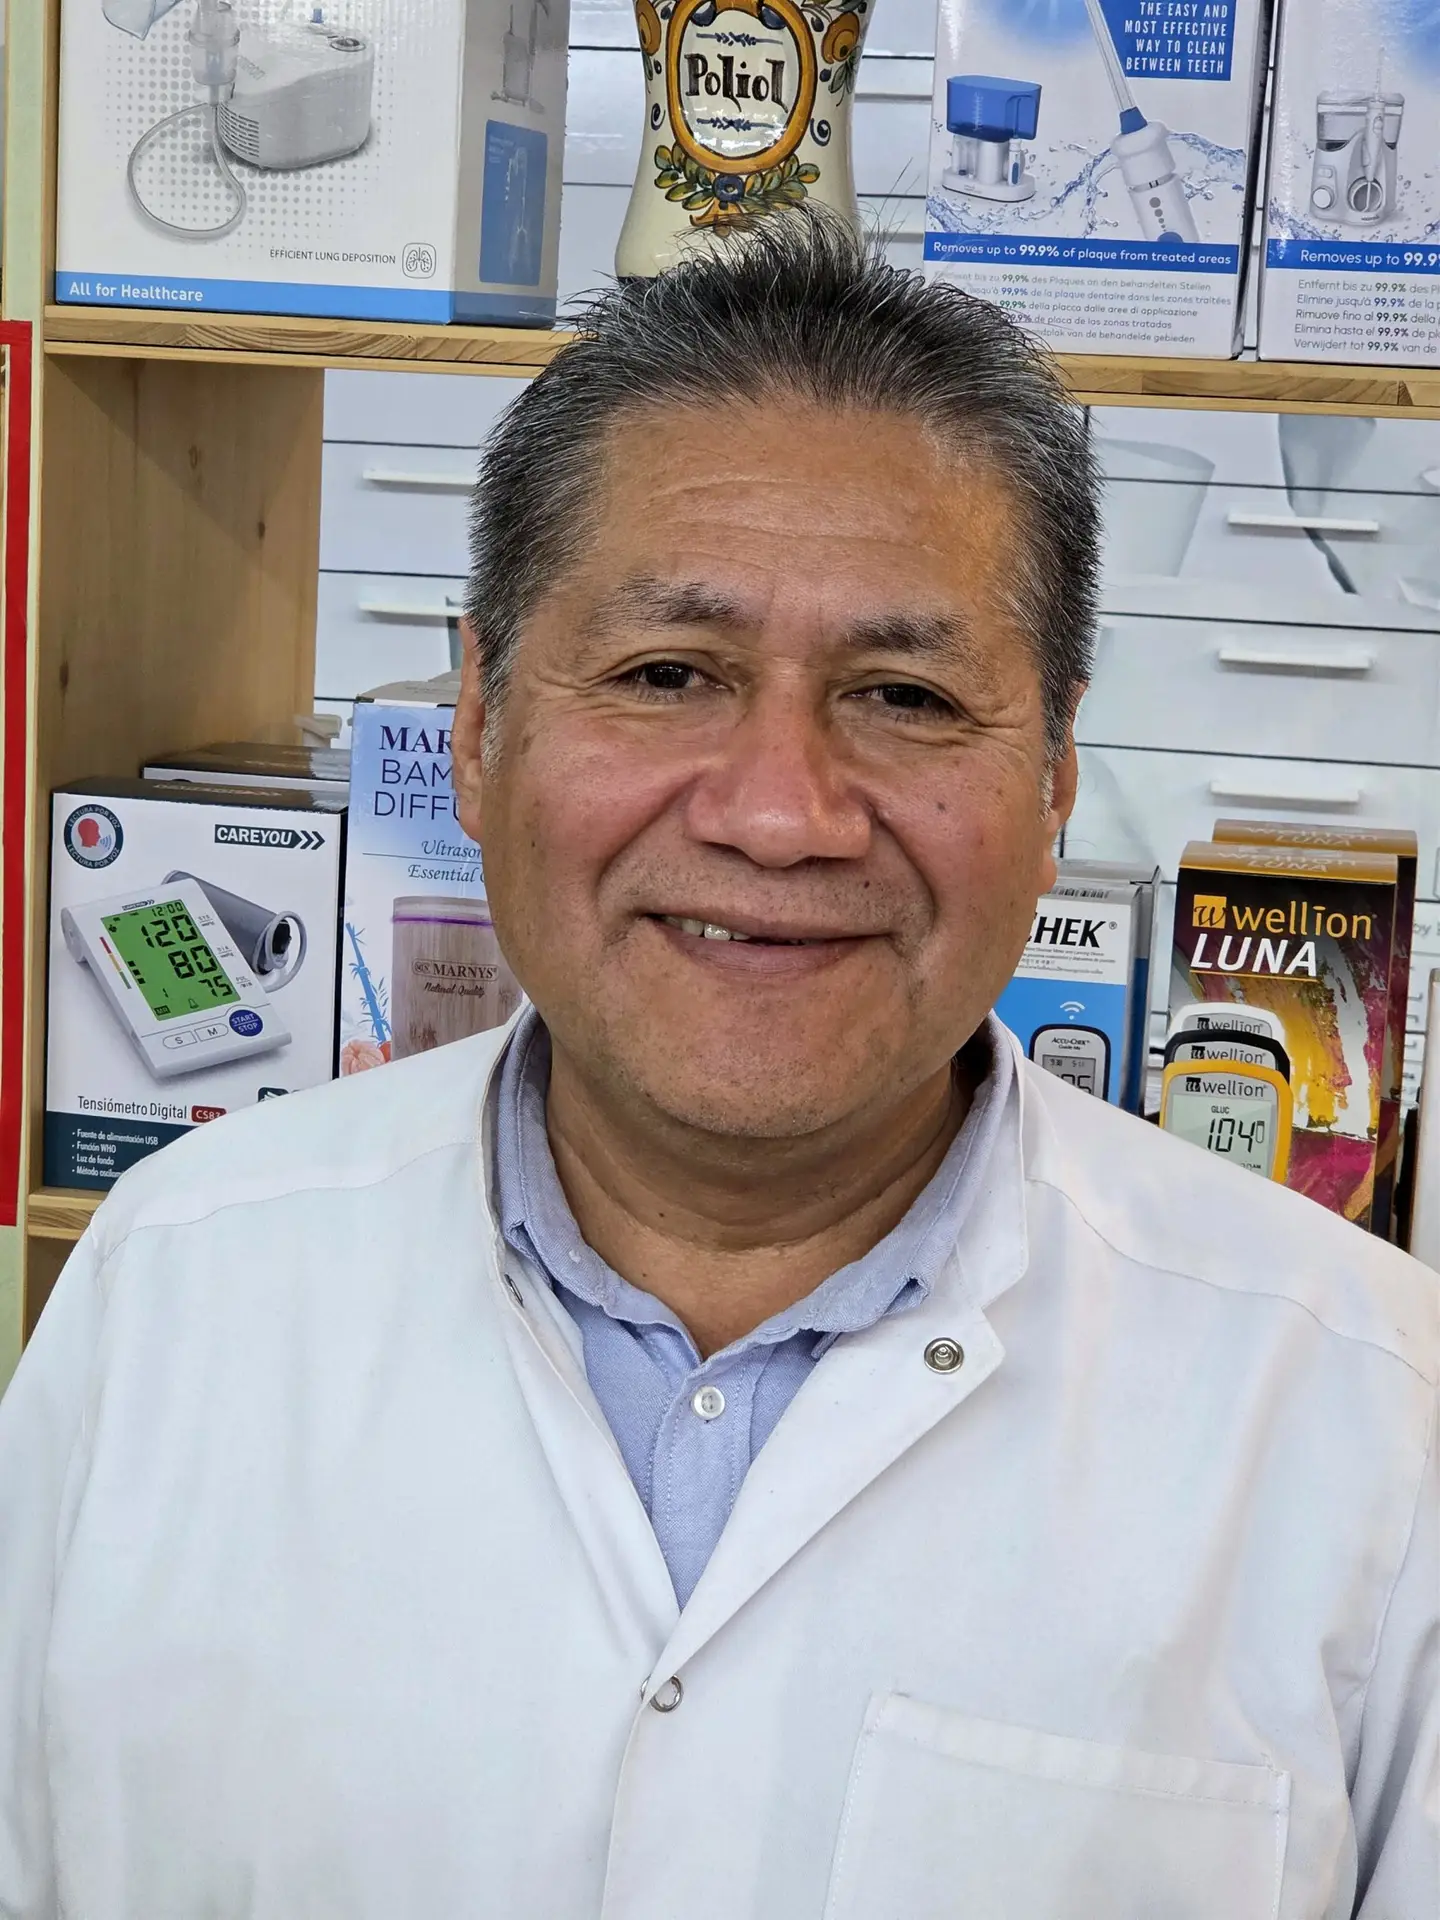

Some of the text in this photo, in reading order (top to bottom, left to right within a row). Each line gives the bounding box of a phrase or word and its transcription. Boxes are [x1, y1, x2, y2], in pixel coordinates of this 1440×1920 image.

[1140, 2, 1228, 19] THE EASY AND
[1124, 20, 1227, 37] MOST EFFECTIVE
[1136, 38, 1226, 55] WAY TO CLEAN
[1126, 57, 1224, 74] BETWEEN TEETH
[684, 53, 788, 113] Poliol
[270, 249, 396, 264] EFFICIENT LUNG DEPOSITION
[933, 241, 1231, 265] Removes up to 99.9% of plaque from treated areas
[1300, 249, 1440, 268] Removes up to 99.9
[69, 282, 203, 302] All for Healthcare
[1031, 275, 1048, 284] des
[1049, 276, 1086, 286] Plaques
[1087, 278, 1099, 286] an
[1101, 278, 1118, 287] den
[1120, 279, 1177, 290] behandelten
[1179, 282, 1211, 292] Stellen
[1298, 279, 1340, 291] Entfernt
[1342, 280, 1357, 291] bis
[1360, 283, 1373, 292] zu
[1409, 284, 1428, 294] des
[1030, 287, 1042, 297] de
[1044, 288, 1053, 298] la
[1054, 289, 1085, 300] plaque
[1087, 290, 1126, 301] dentaire
[1127, 292, 1150, 302] dans
[1151, 292, 1165, 303] les
[1166, 295, 1194, 304] zones
[1408, 299, 1422, 309] de
[1424, 299, 1434, 309] la
[1028, 301, 1050, 311] della
[1052, 302, 1081, 312] placca
[1083, 304, 1106, 313] dalle
[1107, 306, 1128, 314] aree
[1130, 304, 1139, 314] di
[1140, 306, 1198, 318] applicazione
[1295, 309, 1340, 320] Rimuove
[1342, 310, 1361, 321] fino
[1363, 311, 1374, 321] al
[1410, 314, 1436, 324] della
[1034, 314, 1046, 324] de
[1047, 315, 1073, 327] placa
[1074, 316, 1087, 326] de
[1088, 317, 1102, 326] las
[1103, 318, 1130, 328] zonas
[1131, 318, 1172, 330] tratadas
[1067, 331, 1084, 340] van
[1085, 330, 1097, 339] de
[1099, 330, 1152, 341] behandelde
[1153, 333, 1195, 344] gebieden
[1294, 323, 1332, 335] Elimina
[1334, 324, 1364, 336] hasta
[1365, 326, 1376, 336] el
[1411, 328, 1425, 339] de
[1293, 338, 1347, 352] Verwijdert
[1350, 340, 1365, 350] tot
[1401, 344, 1420, 354] van
[1422, 343, 1437, 354] de
[381, 758, 455, 788] BAM
[216, 826, 293, 846] CAREYOU
[407, 864, 479, 883] Essential
[141, 914, 199, 948] 120
[168, 945, 218, 979] 80
[1190, 933, 1317, 977] LUNA
[433, 963, 494, 979] MARNYS
[198, 975, 233, 998] 75
[231, 1013, 256, 1025] START
[238, 1021, 258, 1033] STOP
[207, 1027, 218, 1036] M
[174, 1036, 184, 1045] S
[78, 1095, 148, 1116] Tensiómetro
[150, 1102, 187, 1120] Digital
[1211, 1105, 1231, 1115] GLUC
[98, 1130, 106, 1140] de
[145, 1135, 159, 1146] USB
[1207, 1118, 1256, 1153] 104
[77, 1141, 117, 1154] Función WHO
[77, 1153, 114, 1166] Luz de fondo
[77, 1165, 99, 1176] Método
